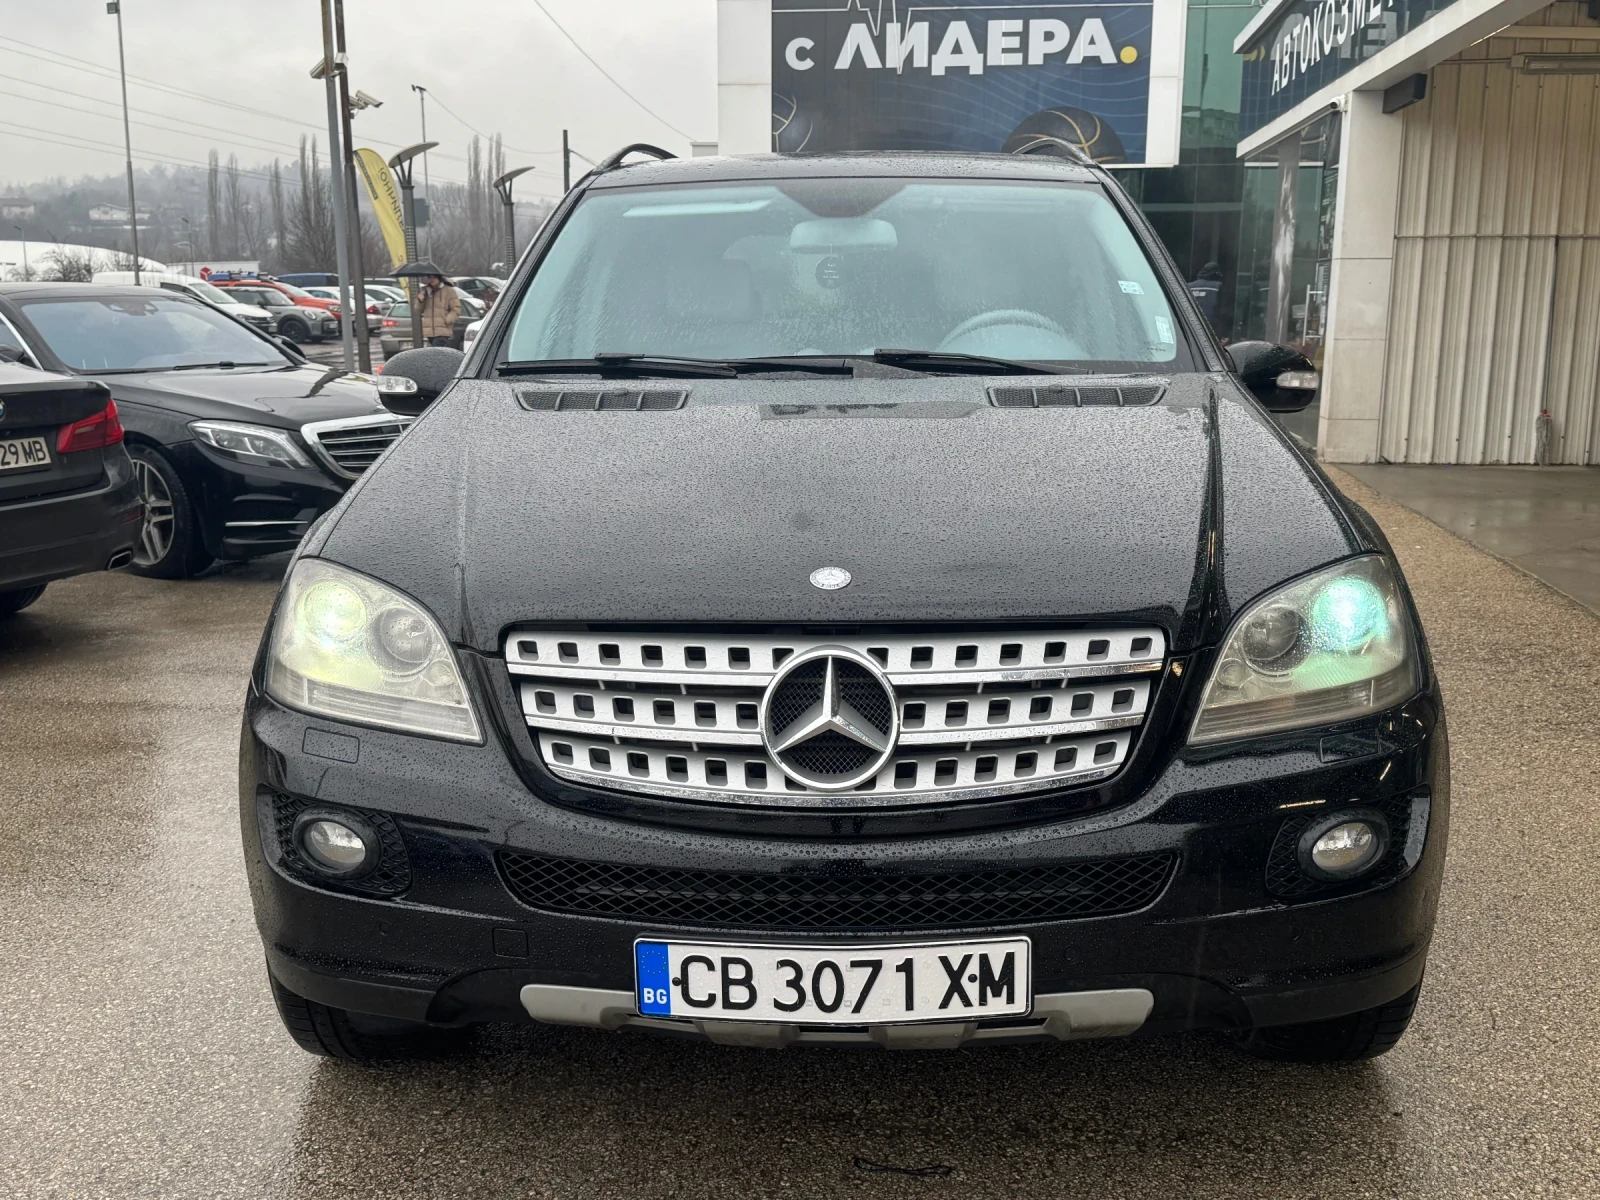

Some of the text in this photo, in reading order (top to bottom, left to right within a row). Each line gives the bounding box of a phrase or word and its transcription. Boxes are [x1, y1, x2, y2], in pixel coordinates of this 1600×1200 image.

[834, 18, 1138, 76] ЛИДЕРА.
[643, 987, 667, 1005] BG
[773, 958, 915, 1014] 3071
